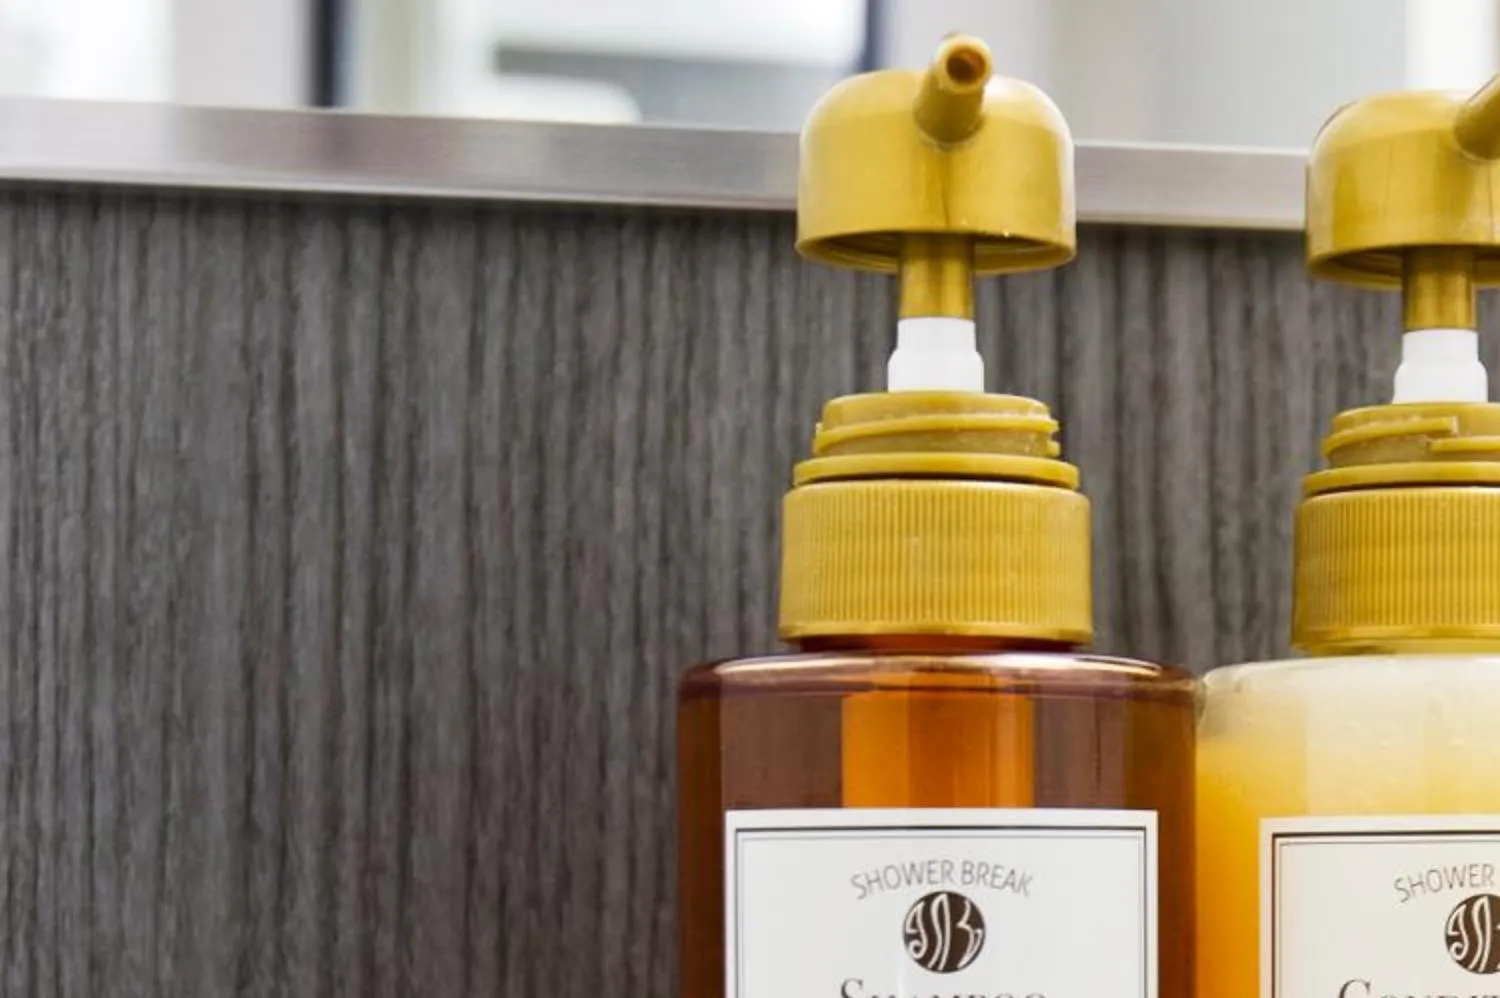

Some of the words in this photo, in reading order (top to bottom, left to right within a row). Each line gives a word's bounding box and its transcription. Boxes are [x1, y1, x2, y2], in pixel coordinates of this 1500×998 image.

[851, 860, 955, 899] SHOWER
[961, 860, 1034, 896] BREAK
[1394, 863, 1495, 902] SHOWER
